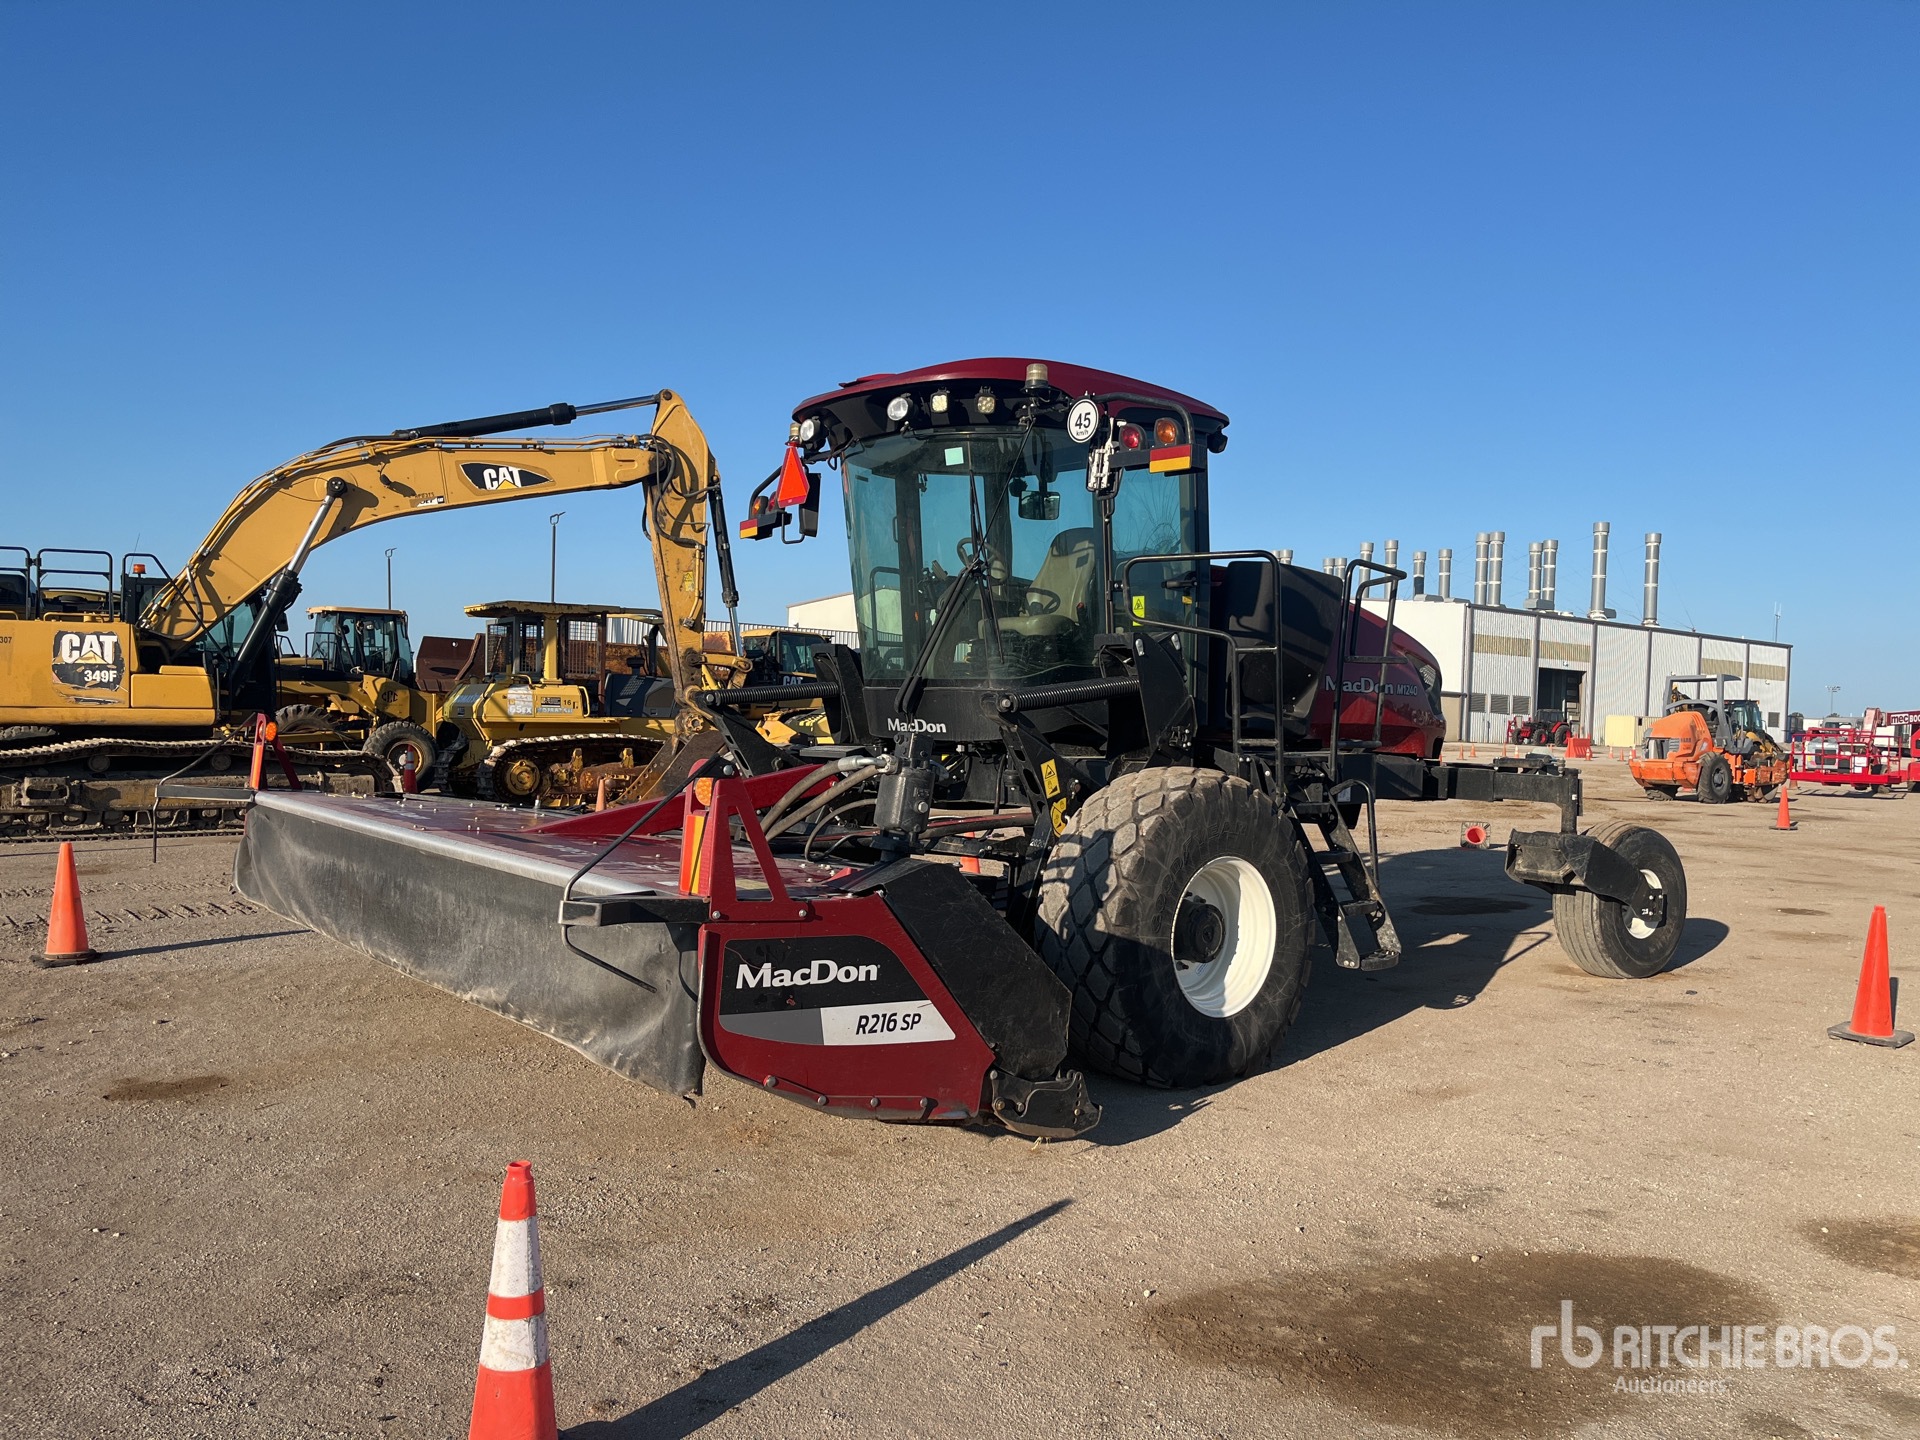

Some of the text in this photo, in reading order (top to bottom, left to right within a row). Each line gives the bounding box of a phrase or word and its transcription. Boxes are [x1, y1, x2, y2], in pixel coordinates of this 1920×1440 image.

[1075, 412, 1091, 429] 45
[1076, 429, 1089, 437] km/h
[483, 466, 522, 490] CAT
[61, 633, 118, 664] CAT
[84, 669, 117, 682] 349F
[783, 675, 803, 686] CAT
[1396, 684, 1418, 696] M1240
[887, 718, 947, 733] MacDon
[1891, 714, 1908, 724] mec
[735, 959, 878, 989] MacDon
[856, 1013, 922, 1035] R216 SP
